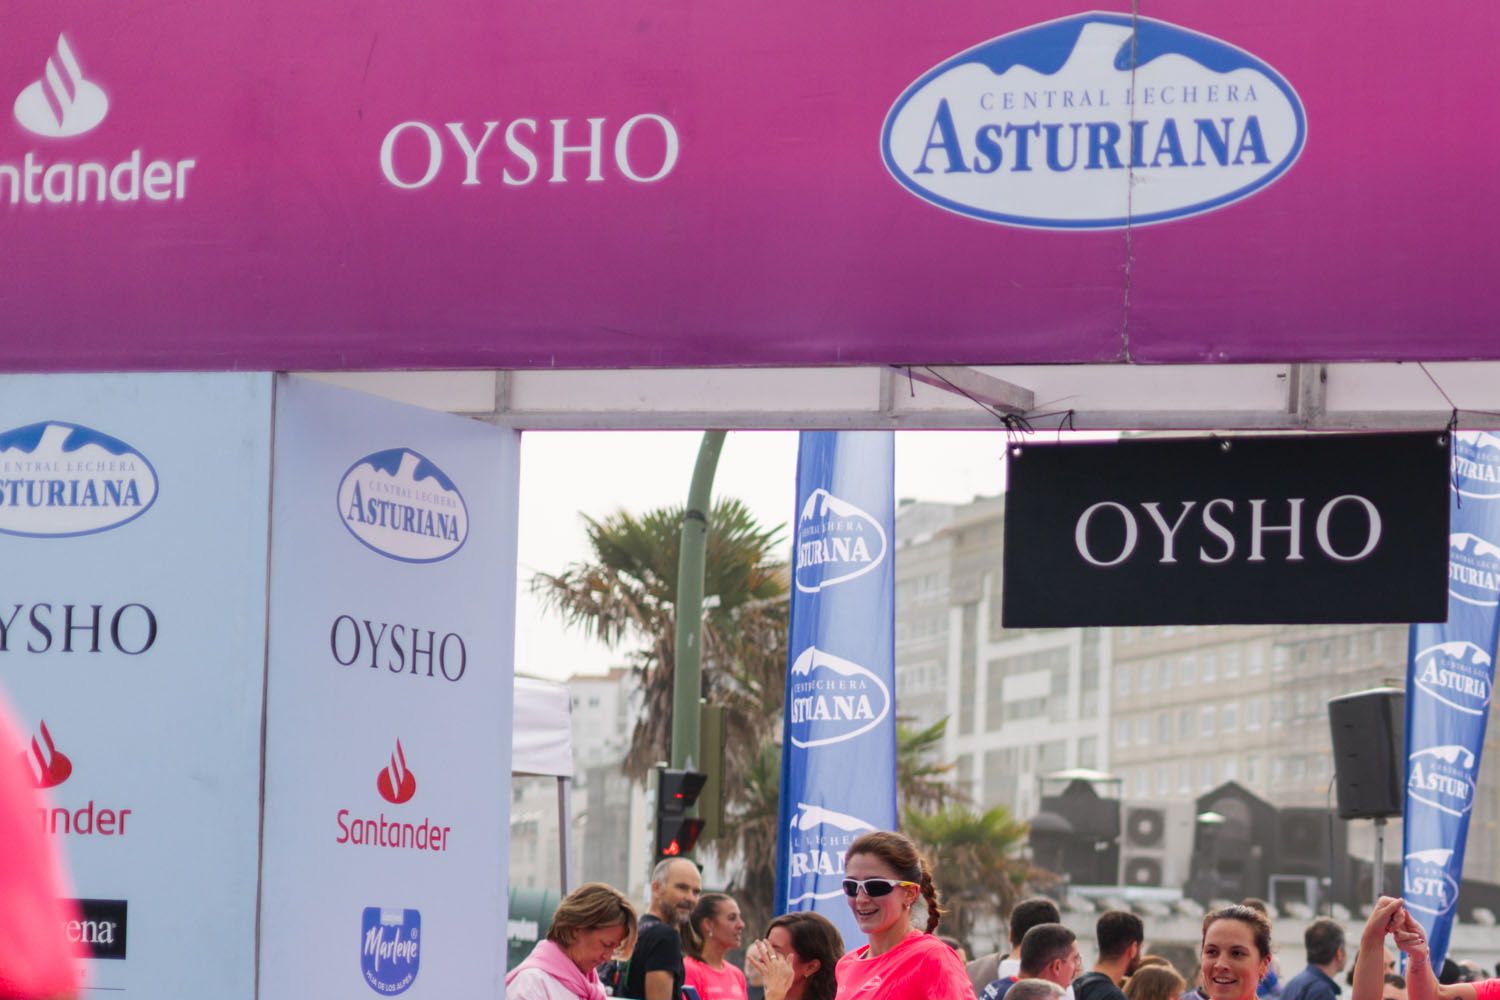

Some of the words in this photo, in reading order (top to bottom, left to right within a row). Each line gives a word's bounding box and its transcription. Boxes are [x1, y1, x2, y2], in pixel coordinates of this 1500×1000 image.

[980, 89, 1110, 111] CENTRAL
[1126, 84, 1259, 106] LECHERA
[379, 113, 679, 189] OYSHO
[912, 98, 1272, 175] ASTURIANA
[67, 461, 136, 472] LECHERA
[347, 480, 459, 541] ASTURIANA
[369, 481, 411, 498] CENTRAL
[415, 490, 457, 508] LECHERA
[1075, 494, 1382, 566] OYSHO
[330, 614, 466, 682] OYSHO
[336, 809, 450, 851] Santander
[364, 926, 417, 972] Marlene
